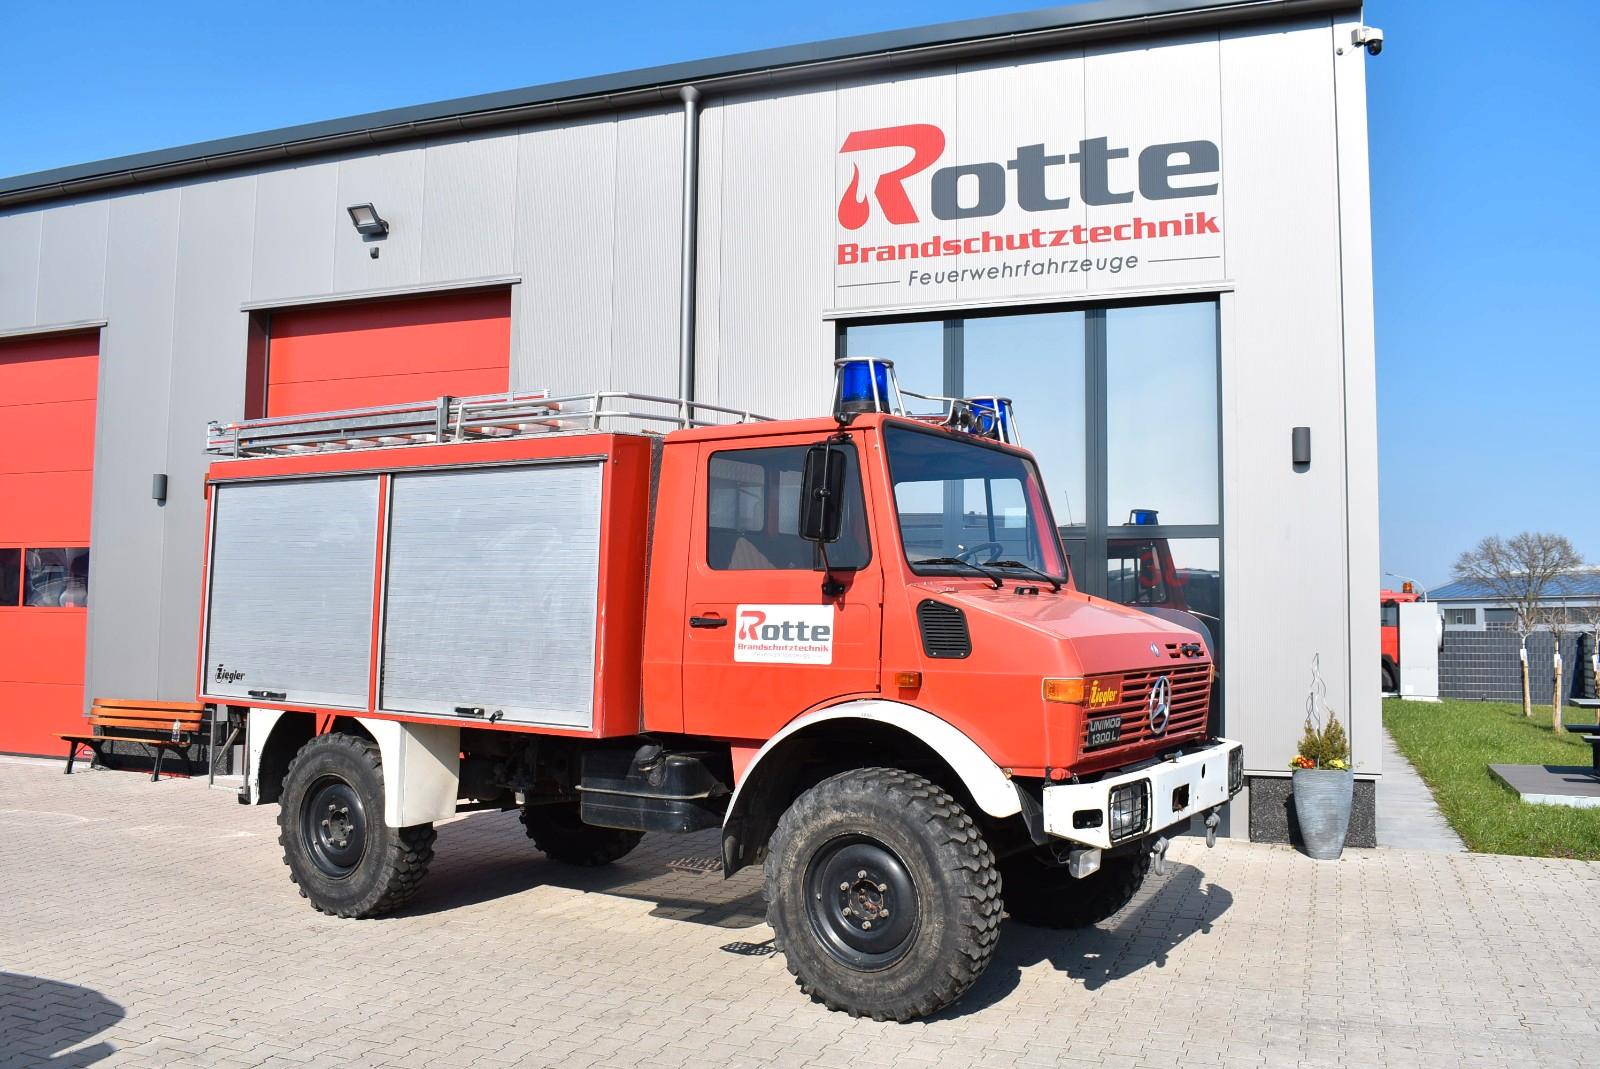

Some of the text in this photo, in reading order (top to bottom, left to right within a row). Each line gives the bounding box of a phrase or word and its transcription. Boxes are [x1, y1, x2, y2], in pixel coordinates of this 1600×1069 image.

[837, 123, 1220, 231] Rotte
[837, 211, 1221, 265] Brandschutztechnik
[907, 254, 1139, 287] Feuerwehrfahrzeuge
[738, 610, 831, 642] Rotte
[737, 643, 829, 652] Brandschutztechnik
[214, 664, 246, 684] Ziegler
[1089, 680, 1118, 709] Ziegler
[1090, 717, 1121, 732] UNIMOG
[1092, 731, 1111, 745] 1300
